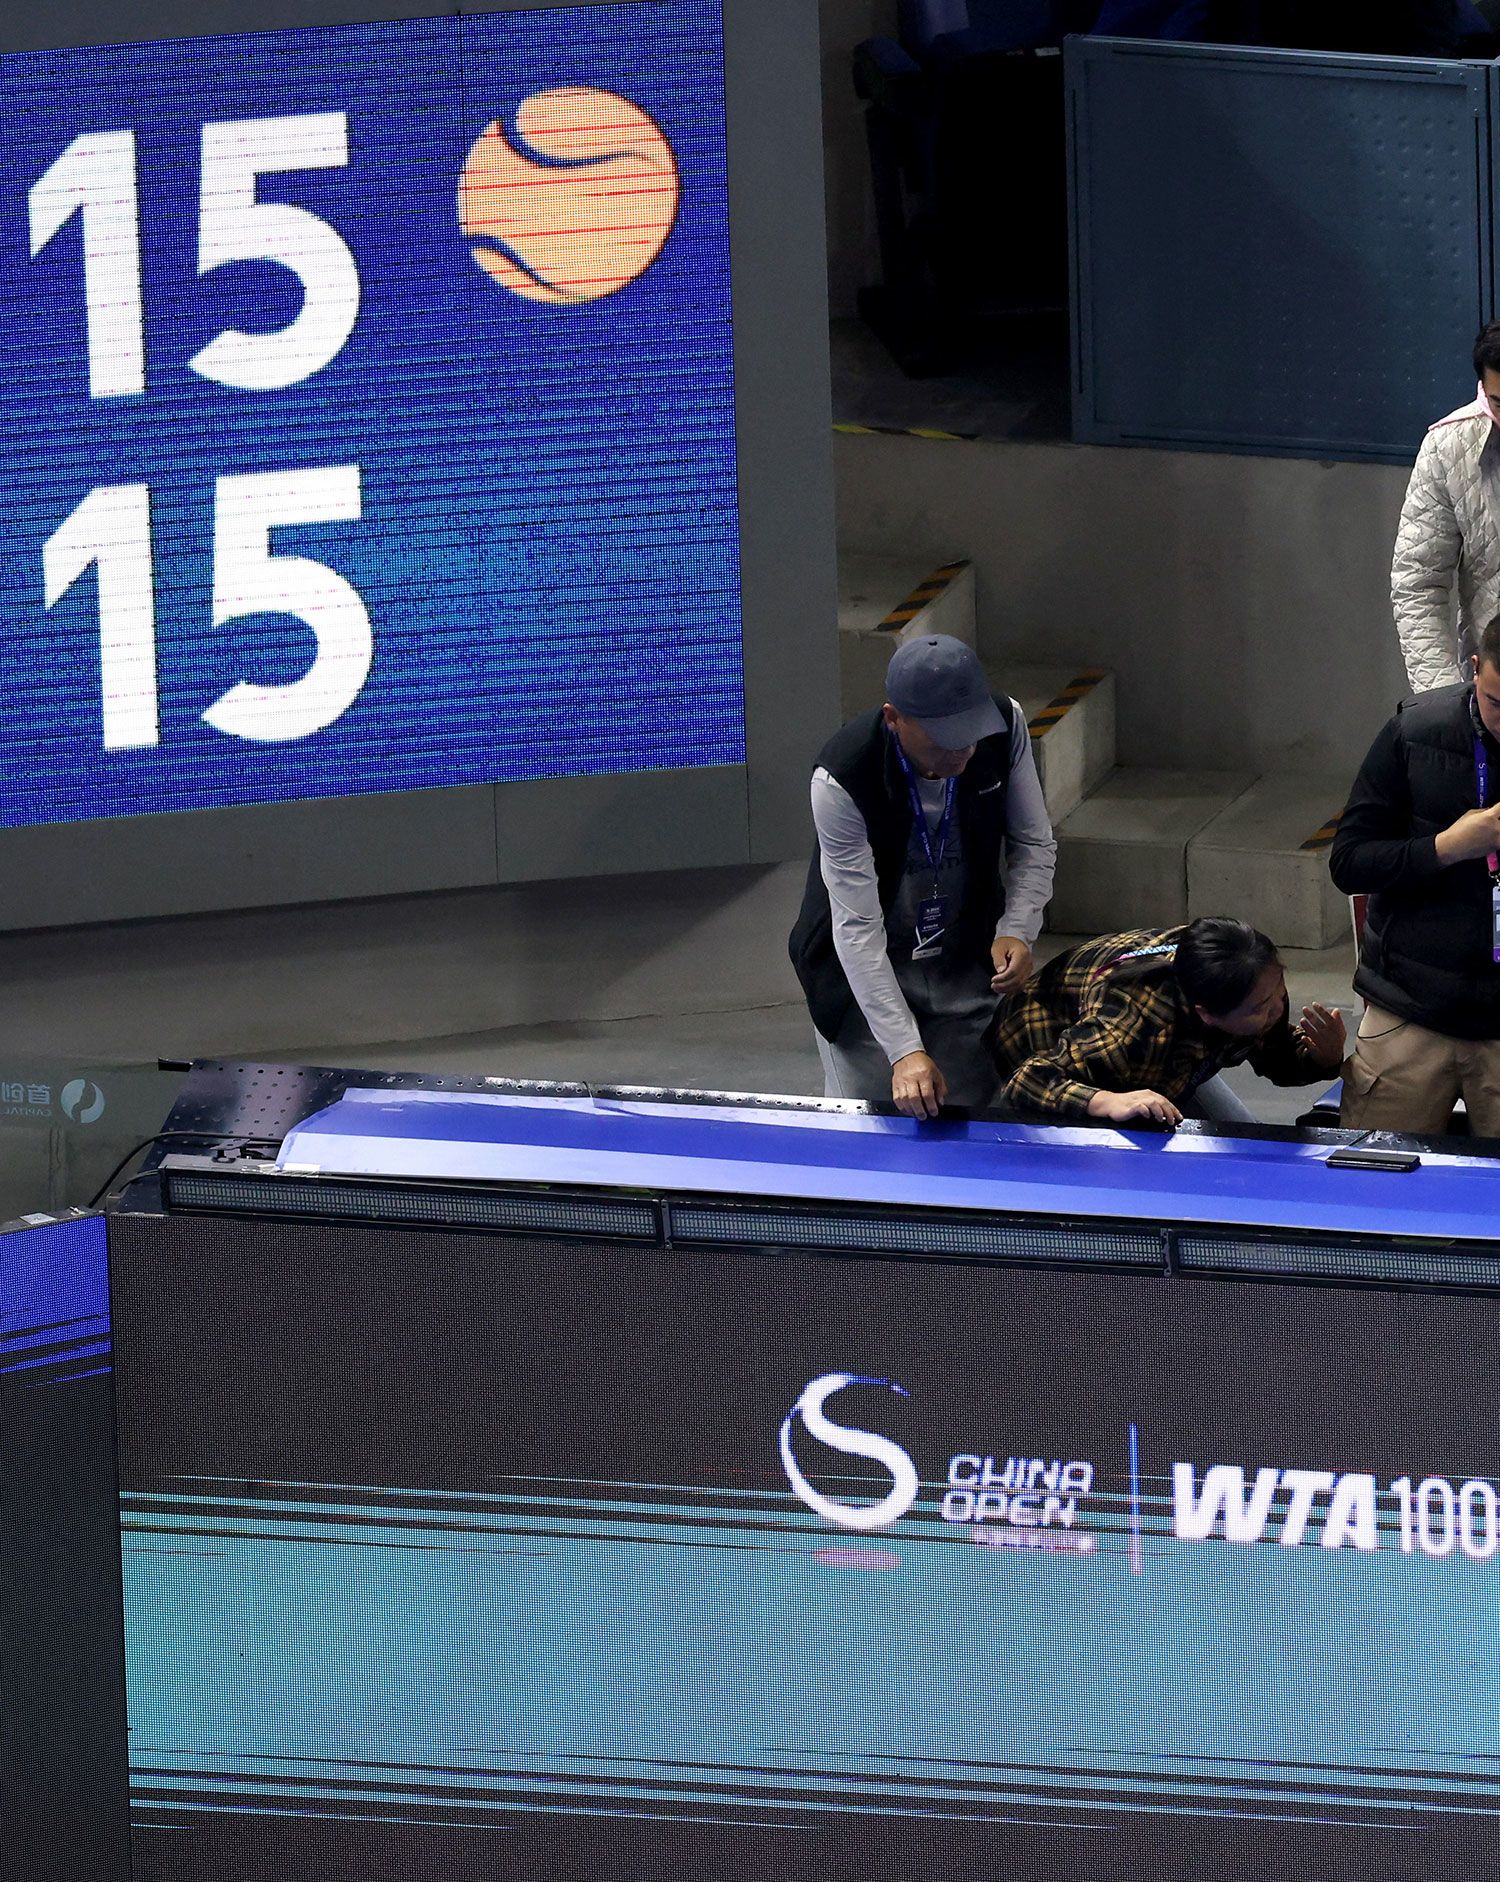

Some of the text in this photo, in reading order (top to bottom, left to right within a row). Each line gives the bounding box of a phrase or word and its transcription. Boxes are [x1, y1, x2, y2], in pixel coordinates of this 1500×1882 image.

[28, 111, 361, 400] 15
[42, 464, 375, 751] 15
[941, 1490, 1080, 1528] OPEN
[947, 1453, 1095, 1493] CHINA
[1171, 1462, 1379, 1551] WTA
